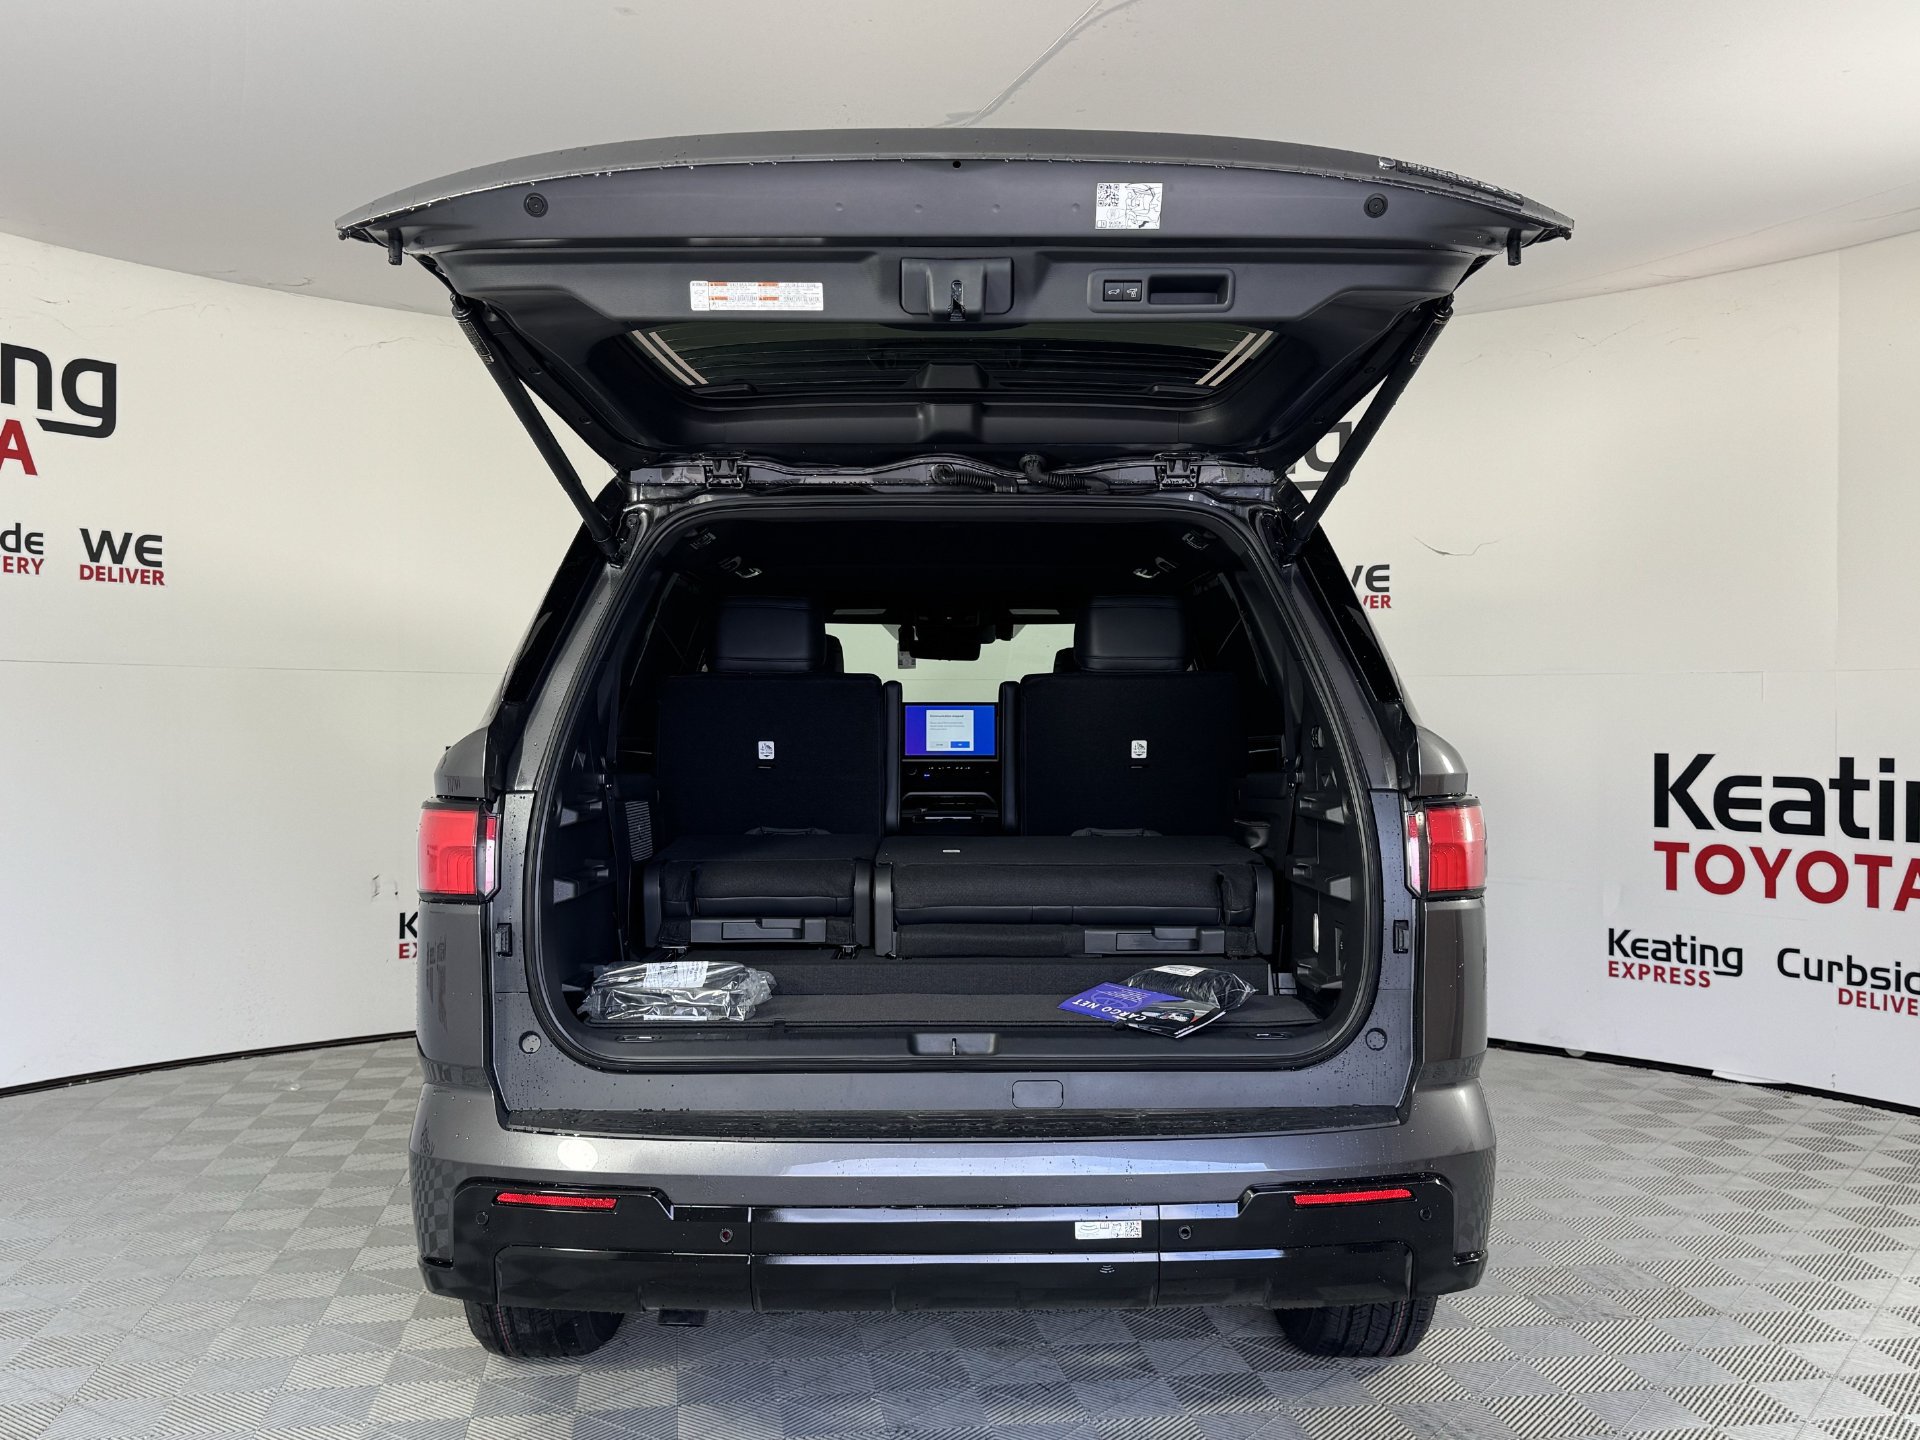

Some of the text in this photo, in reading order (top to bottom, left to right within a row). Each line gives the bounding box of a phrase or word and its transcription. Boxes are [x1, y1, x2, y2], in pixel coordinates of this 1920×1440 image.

[79, 564, 166, 586] DELIVER
[1608, 928, 1743, 977] Keating
[1608, 961, 1712, 988] EXPRESS
[1072, 998, 1147, 1022] CARGO NET
